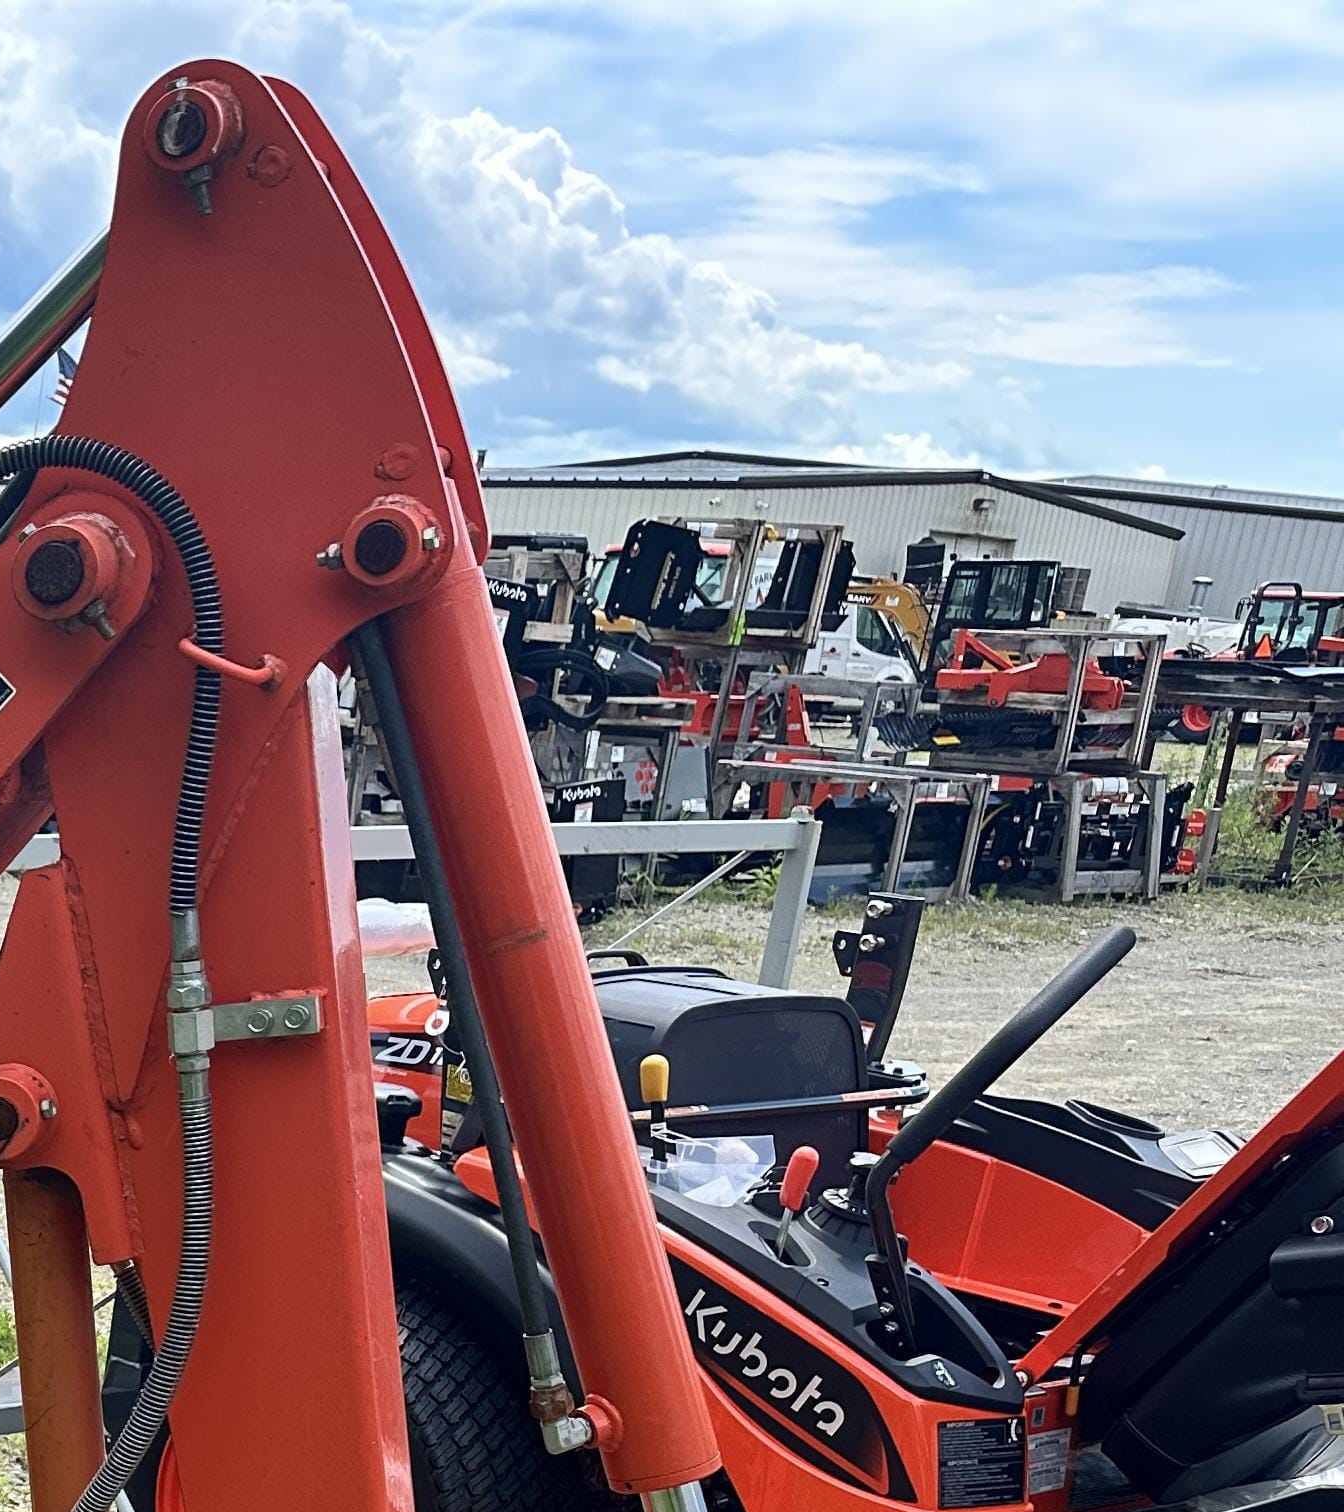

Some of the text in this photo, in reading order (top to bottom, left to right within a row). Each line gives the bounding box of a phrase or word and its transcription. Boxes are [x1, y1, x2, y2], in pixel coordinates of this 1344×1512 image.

[488, 580, 528, 602] Kubota
[562, 785, 602, 802] Kubota
[684, 1288, 845, 1437] Kubota
